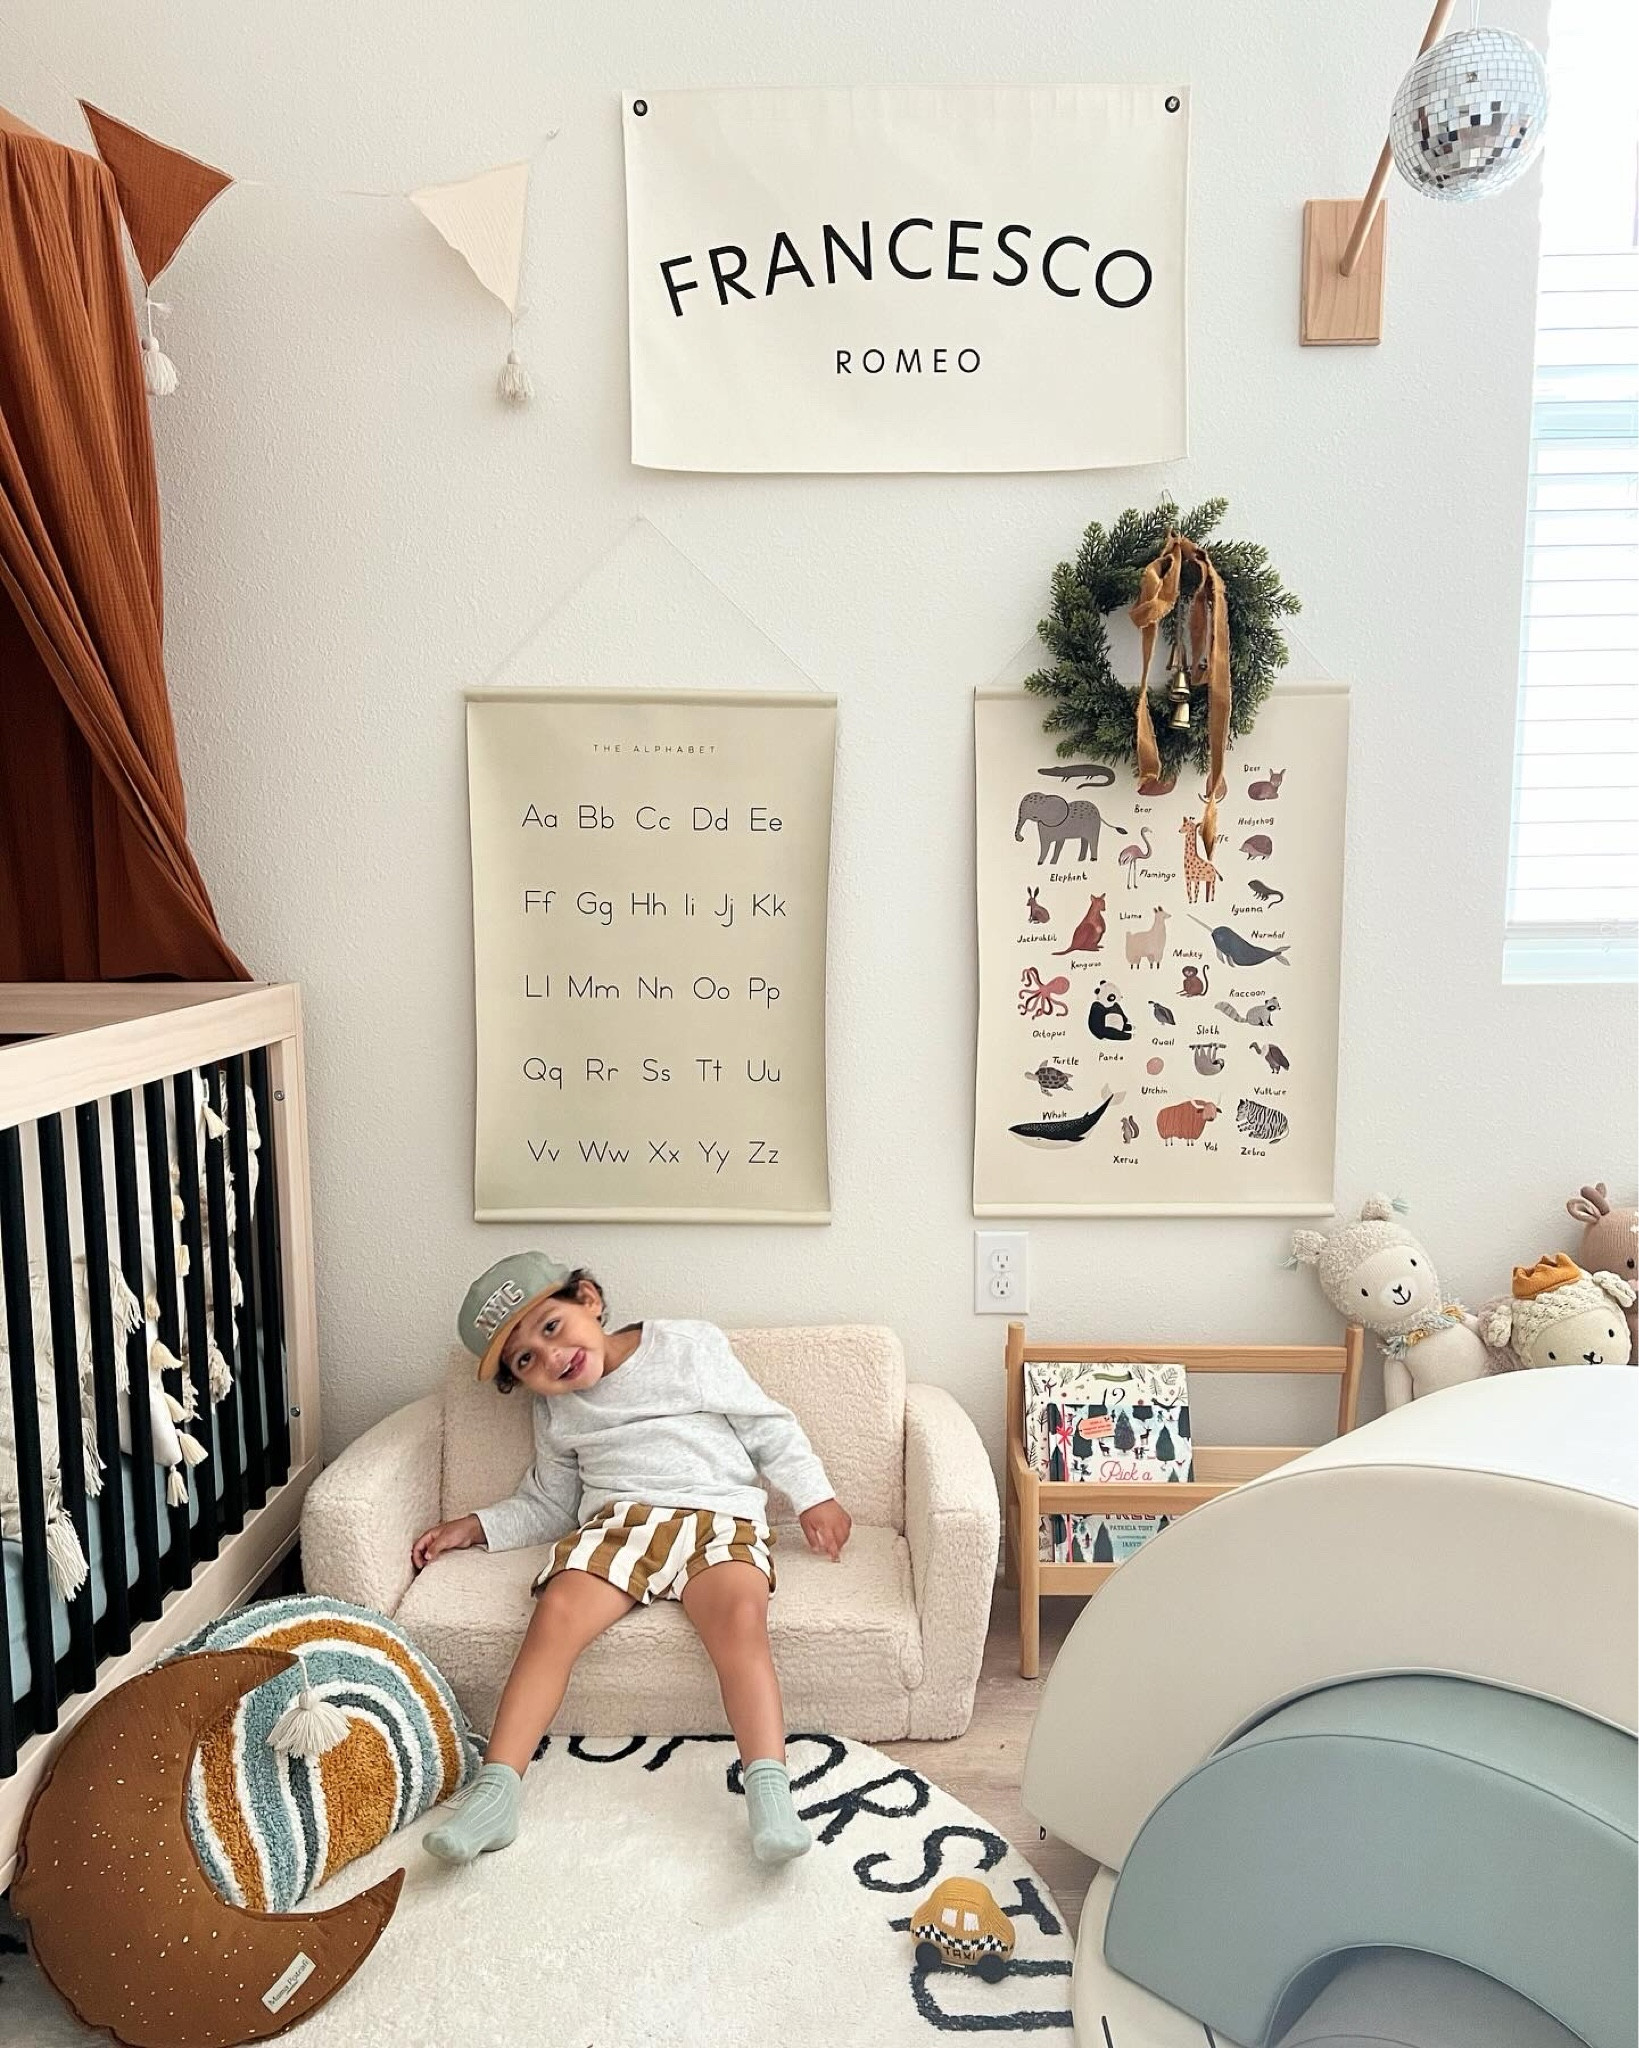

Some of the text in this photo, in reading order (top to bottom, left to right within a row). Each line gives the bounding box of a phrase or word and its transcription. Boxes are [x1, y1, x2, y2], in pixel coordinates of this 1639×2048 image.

[660, 218, 1152, 317] FRANCESCO
[837, 349, 980, 374] ROMEO
[593, 744, 716, 754] THE ALPHABET
[1243, 764, 1261, 773] Deer
[1133, 803, 1153, 814] Bear
[522, 804, 782, 831] Aa Bb Cc Dd Ee
[1237, 817, 1275, 827] Hedgehog
[1049, 872, 1088, 884] Elephant
[1139, 868, 1176, 883] Flamingo
[526, 891, 786, 927] Ff Gg Hh Ii Jj Kk
[1231, 904, 1263, 917] Iguana
[1119, 911, 1142, 921] Llama
[1250, 930, 1286, 939] Narwhal
[1172, 948, 1203, 960] Monkey
[1070, 959, 1102, 971] Kangaroo
[527, 975, 779, 1009] Ll Mm Nn Oo Pp
[1229, 988, 1266, 998] Raccoon
[1032, 1029, 1066, 1040] Octopus
[1196, 1024, 1220, 1035] Sloth
[1151, 1037, 1175, 1046] Quail
[1052, 1056, 1079, 1066] Turtle
[1098, 1052, 1124, 1062] Panda
[524, 1058, 780, 1090] Qq Rr Ss Tt Uu
[1141, 1086, 1168, 1095] Urchin
[1253, 1086, 1287, 1096] Vulture
[1204, 1141, 1218, 1152] Yak
[1240, 1146, 1266, 1157] Zebra
[528, 1140, 778, 1173] Vv Ww Xx Yy Zz
[1113, 1155, 1139, 1165] Xerus
[474, 1280, 525, 1340] NYC
[1100, 1461, 1153, 1481] Pick a
[943, 1946, 976, 1960] TAXI
